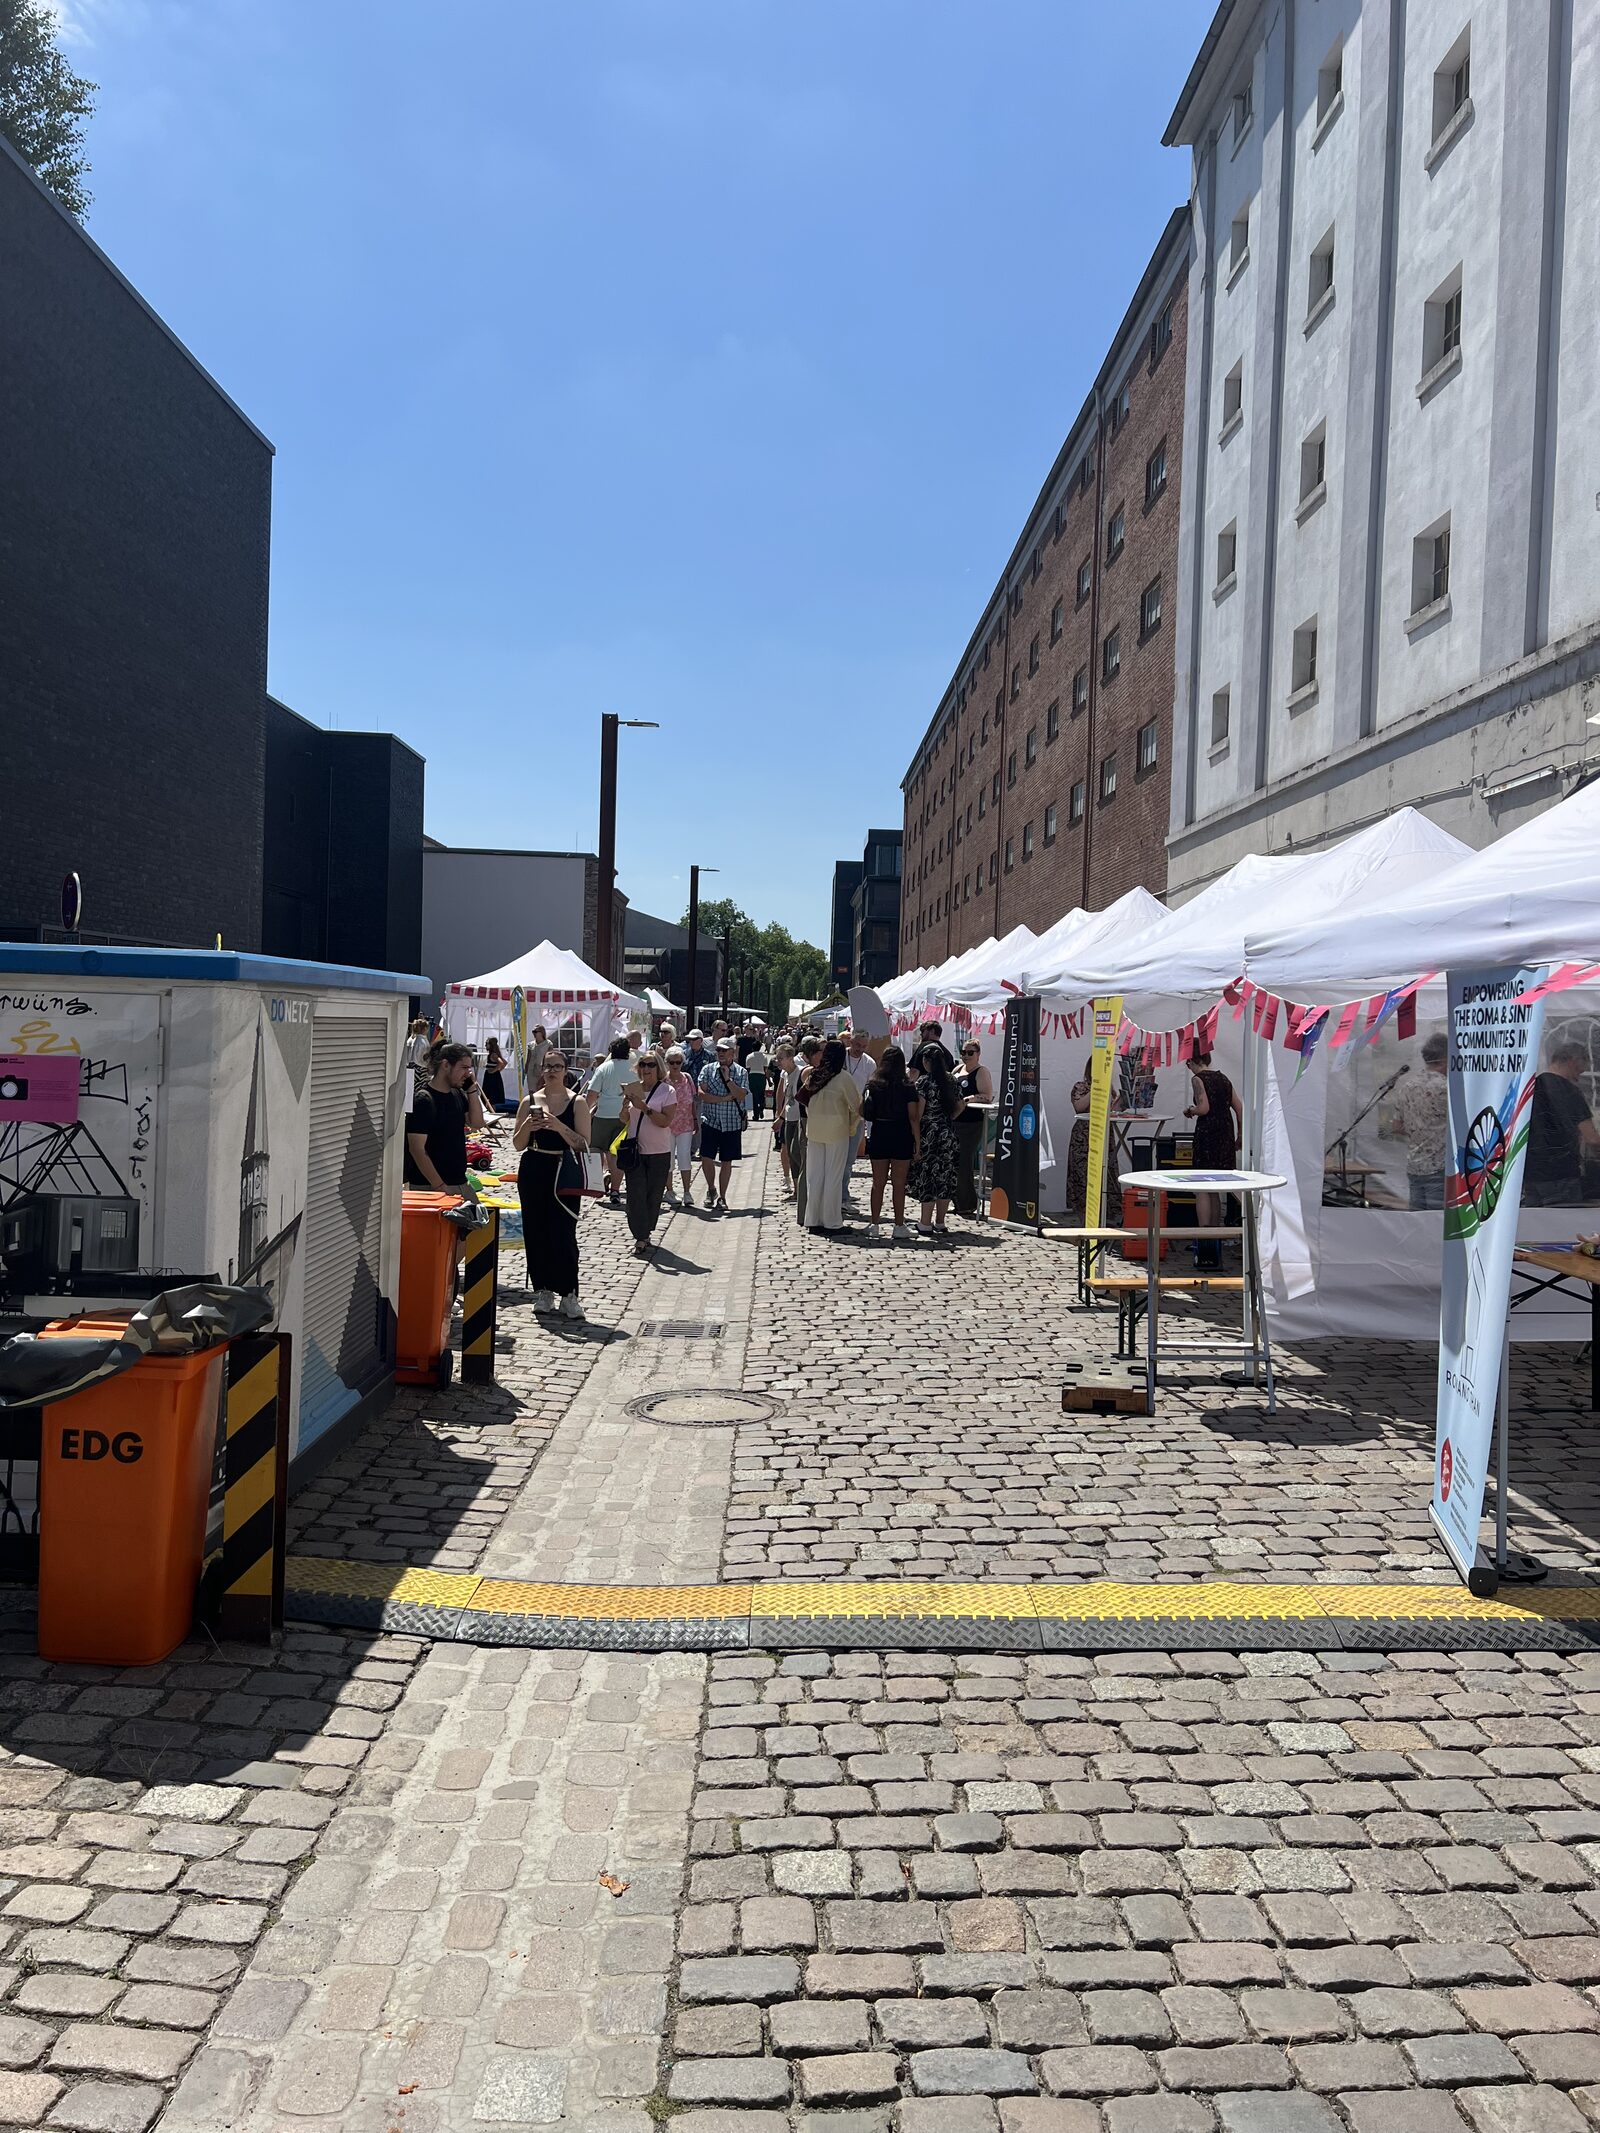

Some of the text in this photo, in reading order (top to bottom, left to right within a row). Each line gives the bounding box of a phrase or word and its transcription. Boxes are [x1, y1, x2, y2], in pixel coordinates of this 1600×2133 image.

[1462, 979, 1524, 1004] EMPOWERING
[271, 998, 309, 1024] DONETZ
[1455, 1009, 1470, 1027] THE
[1471, 1007, 1499, 1026] ROMA
[1501, 1006, 1507, 1023] &
[1518, 1029, 1528, 1048] IN
[1450, 1054, 1498, 1072] DORTMUND
[1499, 1053, 1505, 1073] &
[60, 1428, 144, 1464] EDG
